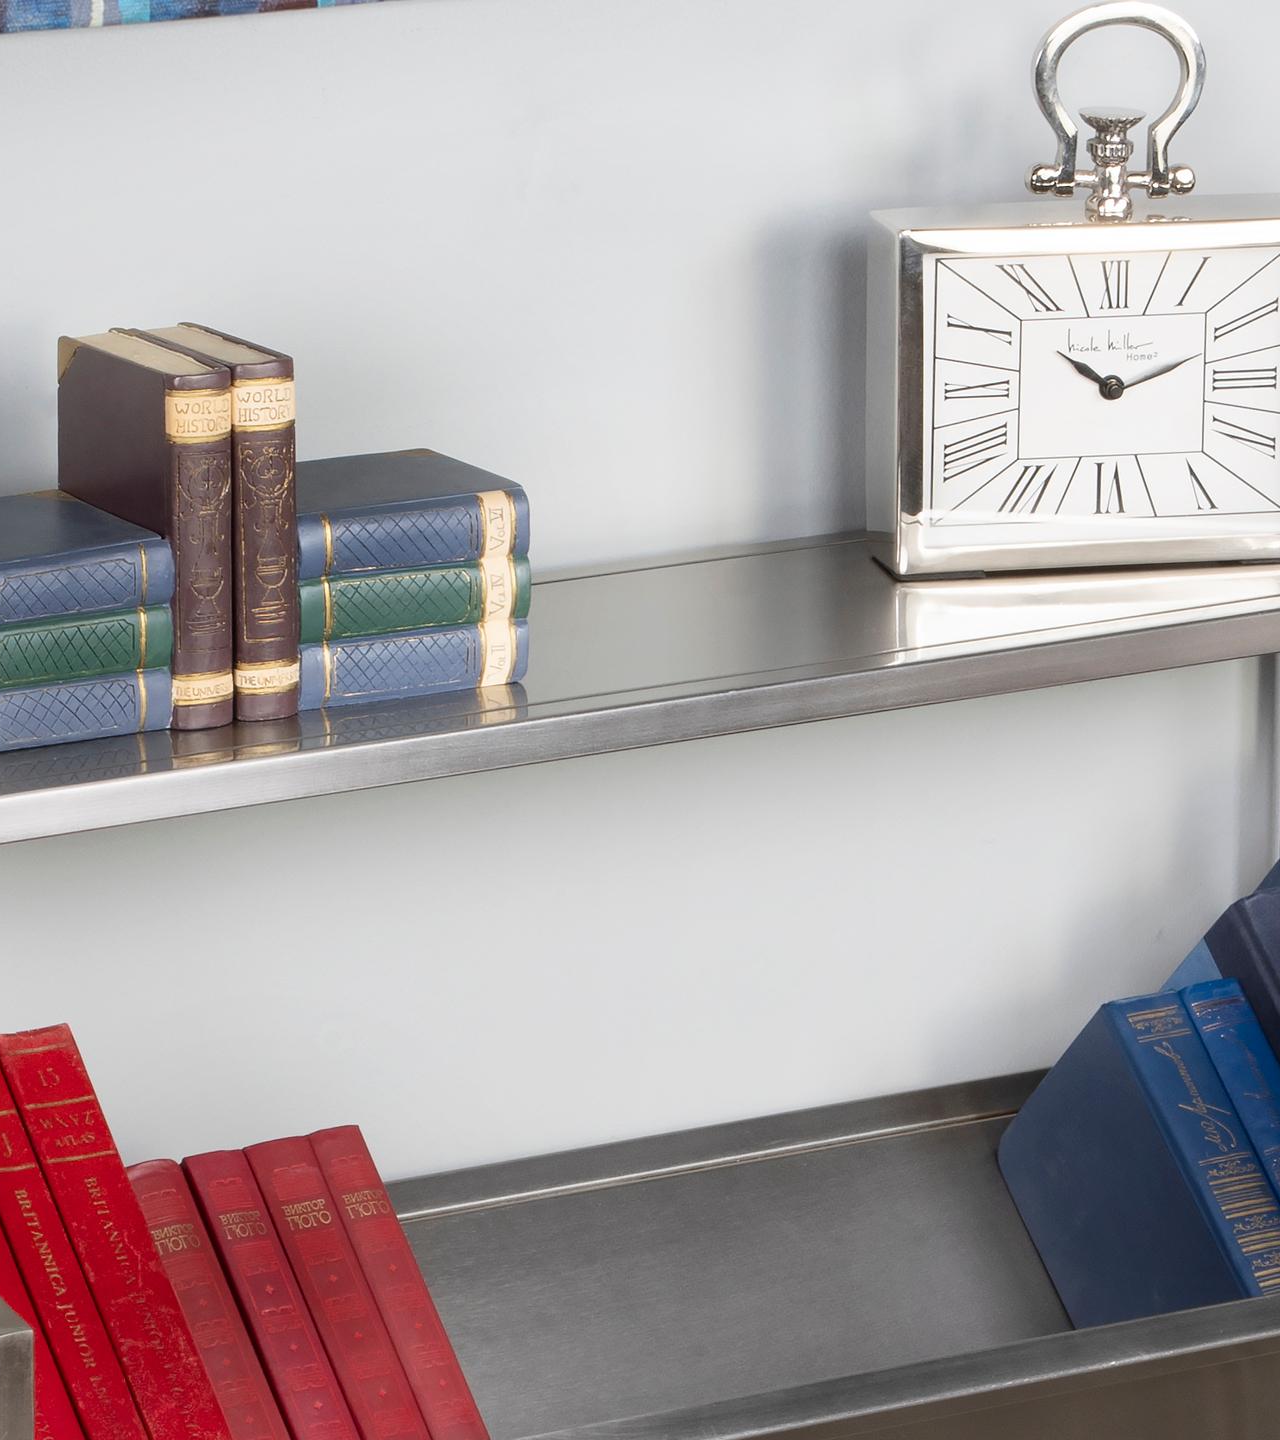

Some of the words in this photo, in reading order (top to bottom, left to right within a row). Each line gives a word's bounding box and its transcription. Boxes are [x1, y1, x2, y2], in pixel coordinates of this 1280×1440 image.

[995, 263, 1065, 313] XI
[1099, 259, 1131, 310] XII
[1212, 365, 1278, 393] III
[236, 387, 292, 404] WORLD
[174, 398, 230, 415] WORLD
[281, 1198, 326, 1217] ВИКТОР
[345, 1200, 391, 1220] ГЮГО
[218, 1210, 260, 1226] ВИКТОР
[286, 1210, 332, 1231] ГЮГО
[151, 1223, 194, 1241] ВИКТОР
[223, 1222, 267, 1240] ГЮГО
[155, 1235, 201, 1256] ГЮГО
[14, 1188, 68, 1298] BRITANNICA
[55, 1300, 97, 1370] JUNIOR
